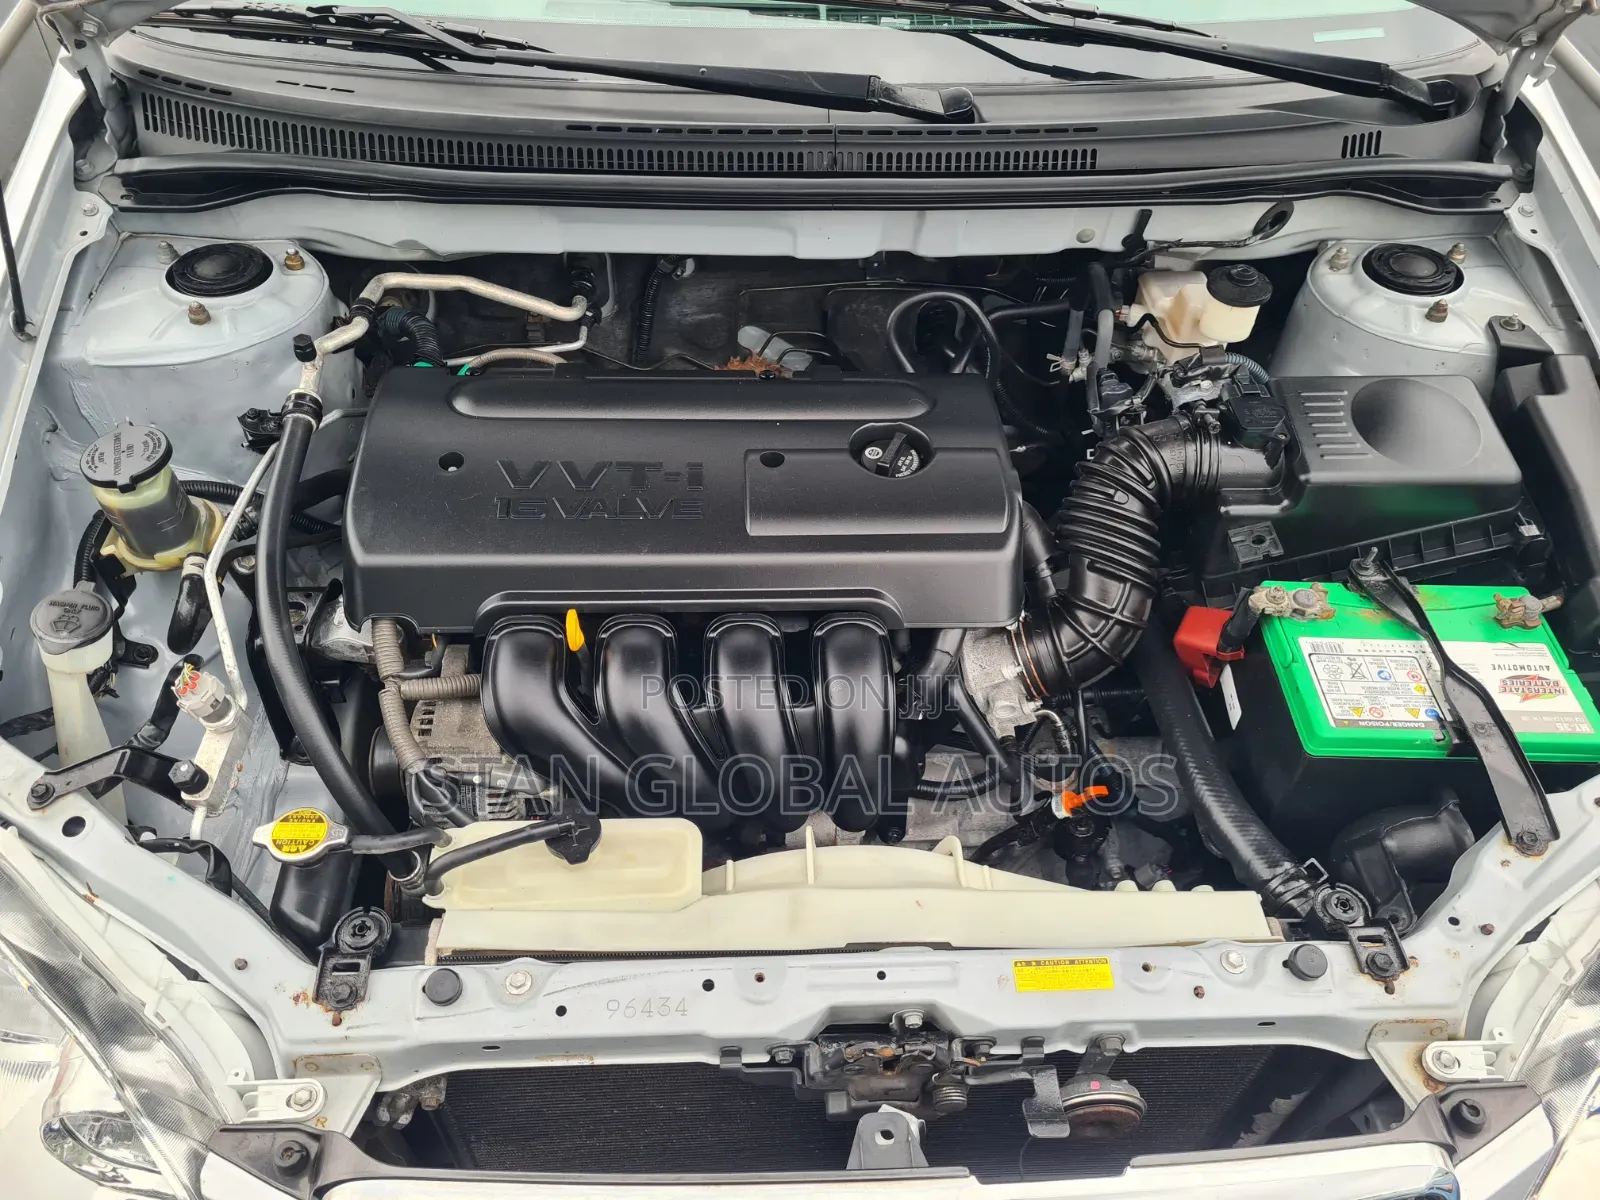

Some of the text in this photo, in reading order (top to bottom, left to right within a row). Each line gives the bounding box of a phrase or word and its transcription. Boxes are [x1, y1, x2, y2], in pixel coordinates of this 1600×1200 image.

[494, 496, 704, 520] 16 VALVE
[1490, 663, 1551, 672] AUTOMOTIVE
[1501, 679, 1560, 687] BATTERIES
[1498, 686, 1565, 695] INTERSTATE
[1074, 957, 1108, 965] ATTENTION
[606, 996, 688, 1020] 96434
